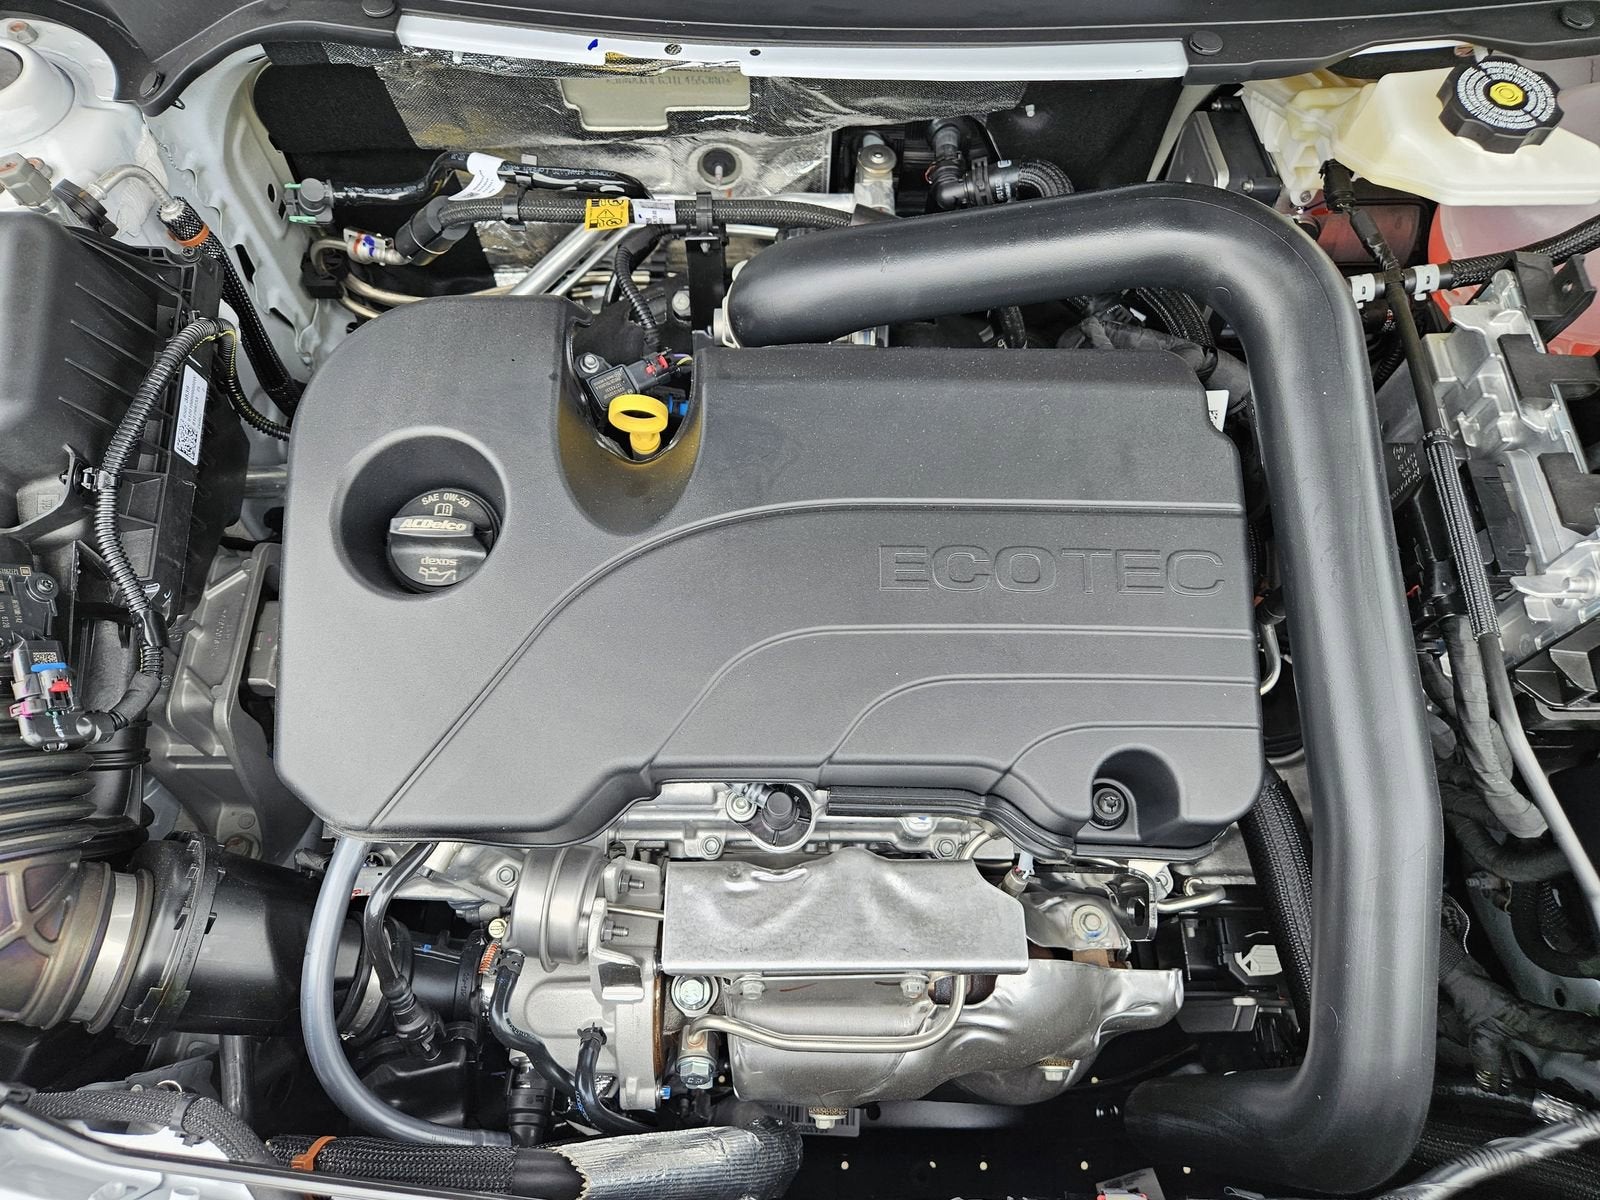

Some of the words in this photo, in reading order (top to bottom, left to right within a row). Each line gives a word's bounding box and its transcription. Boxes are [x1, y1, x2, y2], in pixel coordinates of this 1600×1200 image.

[421, 493, 440, 506] SAE
[443, 492, 471, 508] 0W-20
[399, 518, 467, 531] ACDelco
[420, 556, 457, 565] dexos
[878, 544, 1225, 597] ECOTEC
